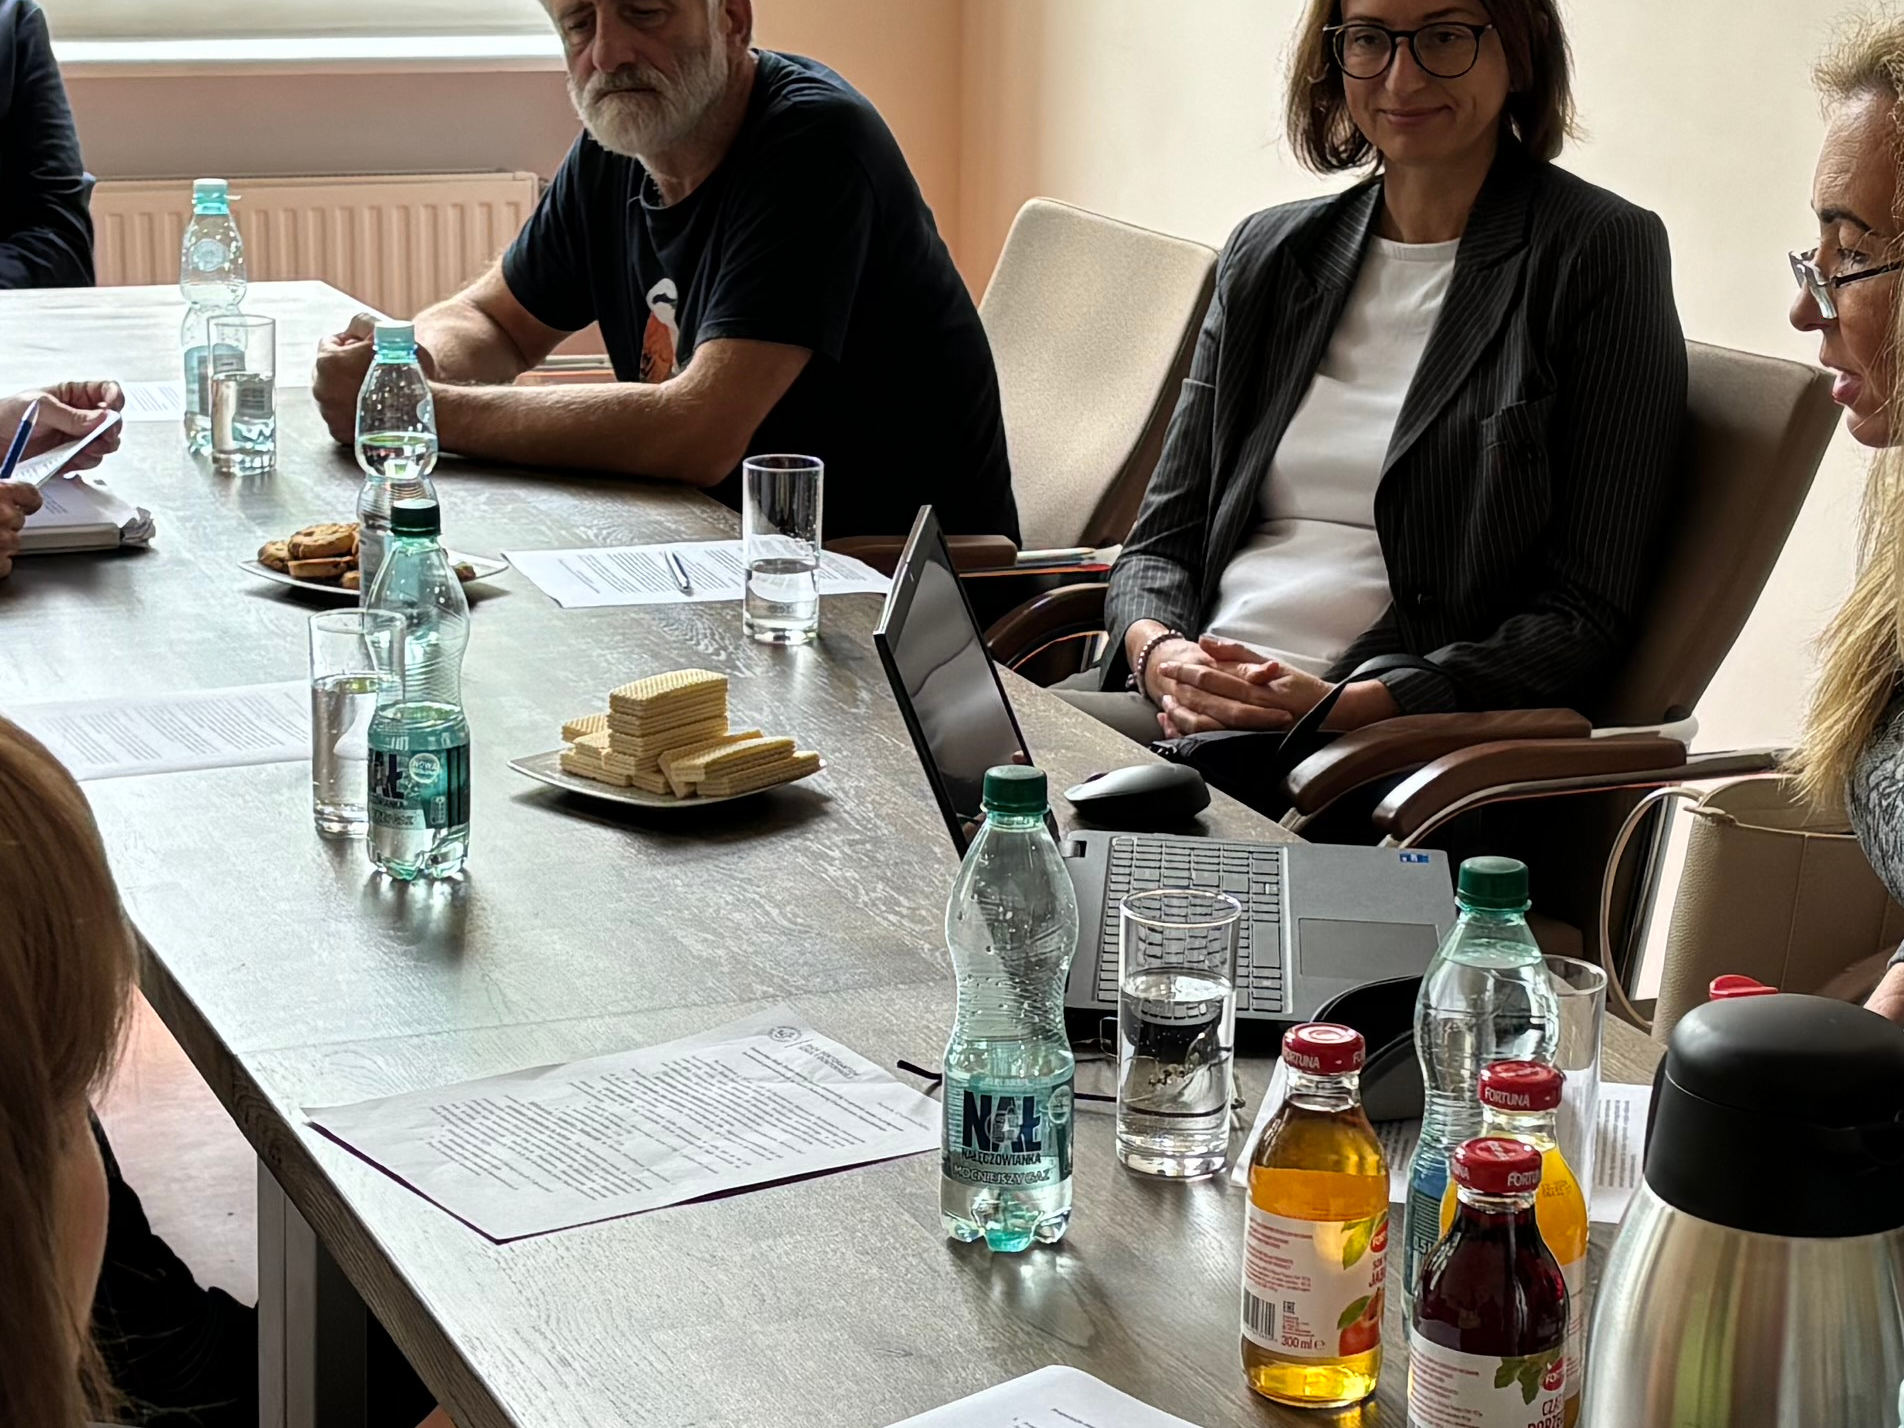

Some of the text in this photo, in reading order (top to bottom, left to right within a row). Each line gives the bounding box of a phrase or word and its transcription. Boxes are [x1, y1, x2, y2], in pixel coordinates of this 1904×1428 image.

[1484, 1086, 1530, 1107] FORTUNA
[962, 1090, 1042, 1152] NAŁ
[1281, 1335, 1313, 1349] 300 ml
